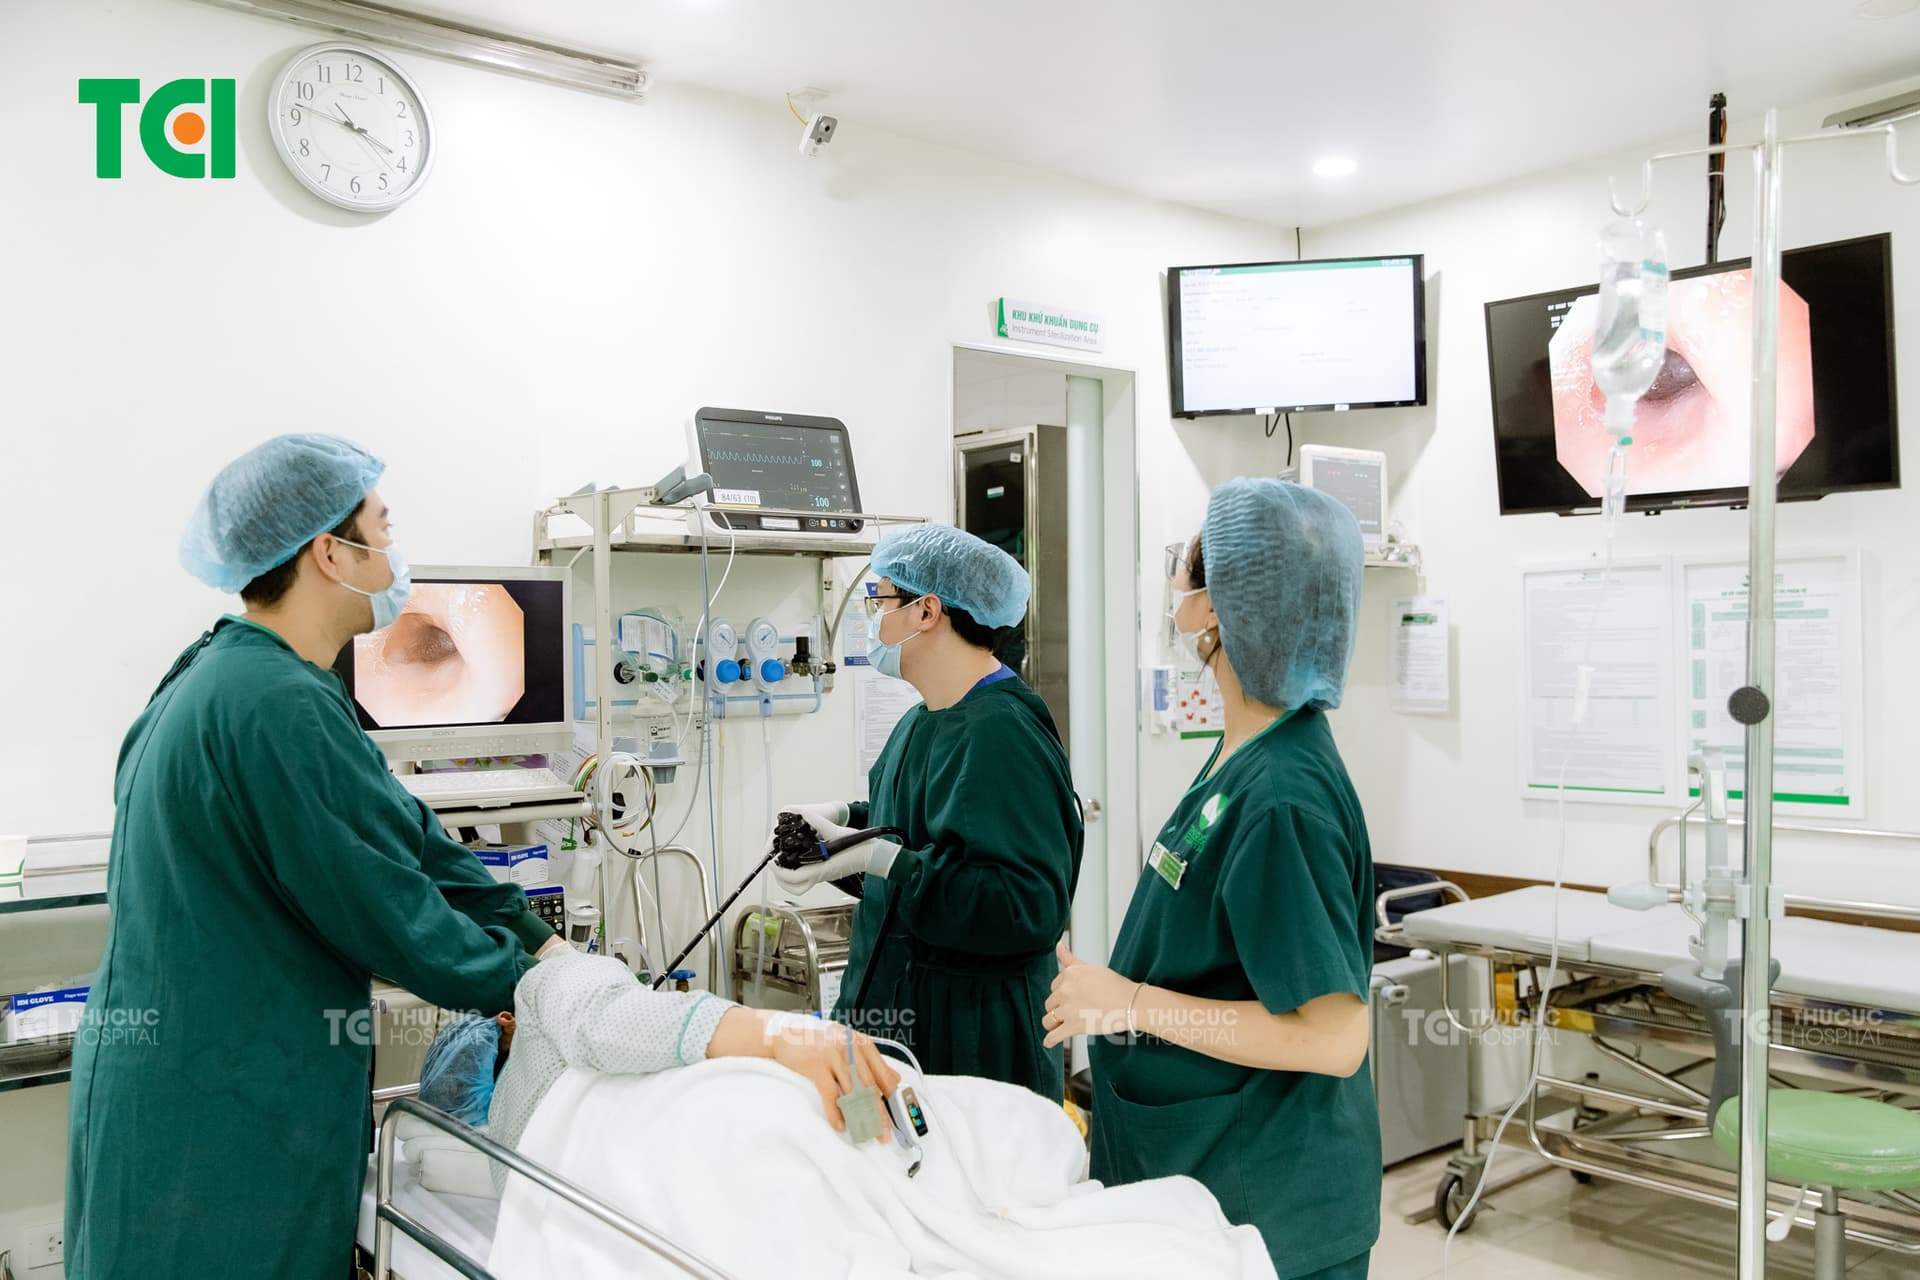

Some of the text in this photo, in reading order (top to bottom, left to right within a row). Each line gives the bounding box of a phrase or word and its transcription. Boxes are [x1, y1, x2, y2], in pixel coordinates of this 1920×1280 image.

[317, 64, 331, 84] 11
[345, 63, 364, 83] 12
[295, 81, 314, 101] 10
[378, 77, 385, 95] 1
[290, 107, 302, 127] 9
[396, 100, 407, 119] 2
[299, 137, 310, 158] 8
[403, 129, 414, 148] 3
[320, 163, 332, 182] 7
[396, 156, 408, 174] 4
[350, 175, 361, 194] 6
[377, 172, 388, 191] 5
[1011, 309, 1027, 321] KHU
[1011, 324, 1046, 336] Instrument
[815, 496, 830, 508] 100
[29, 995, 54, 1005] GLOVE
